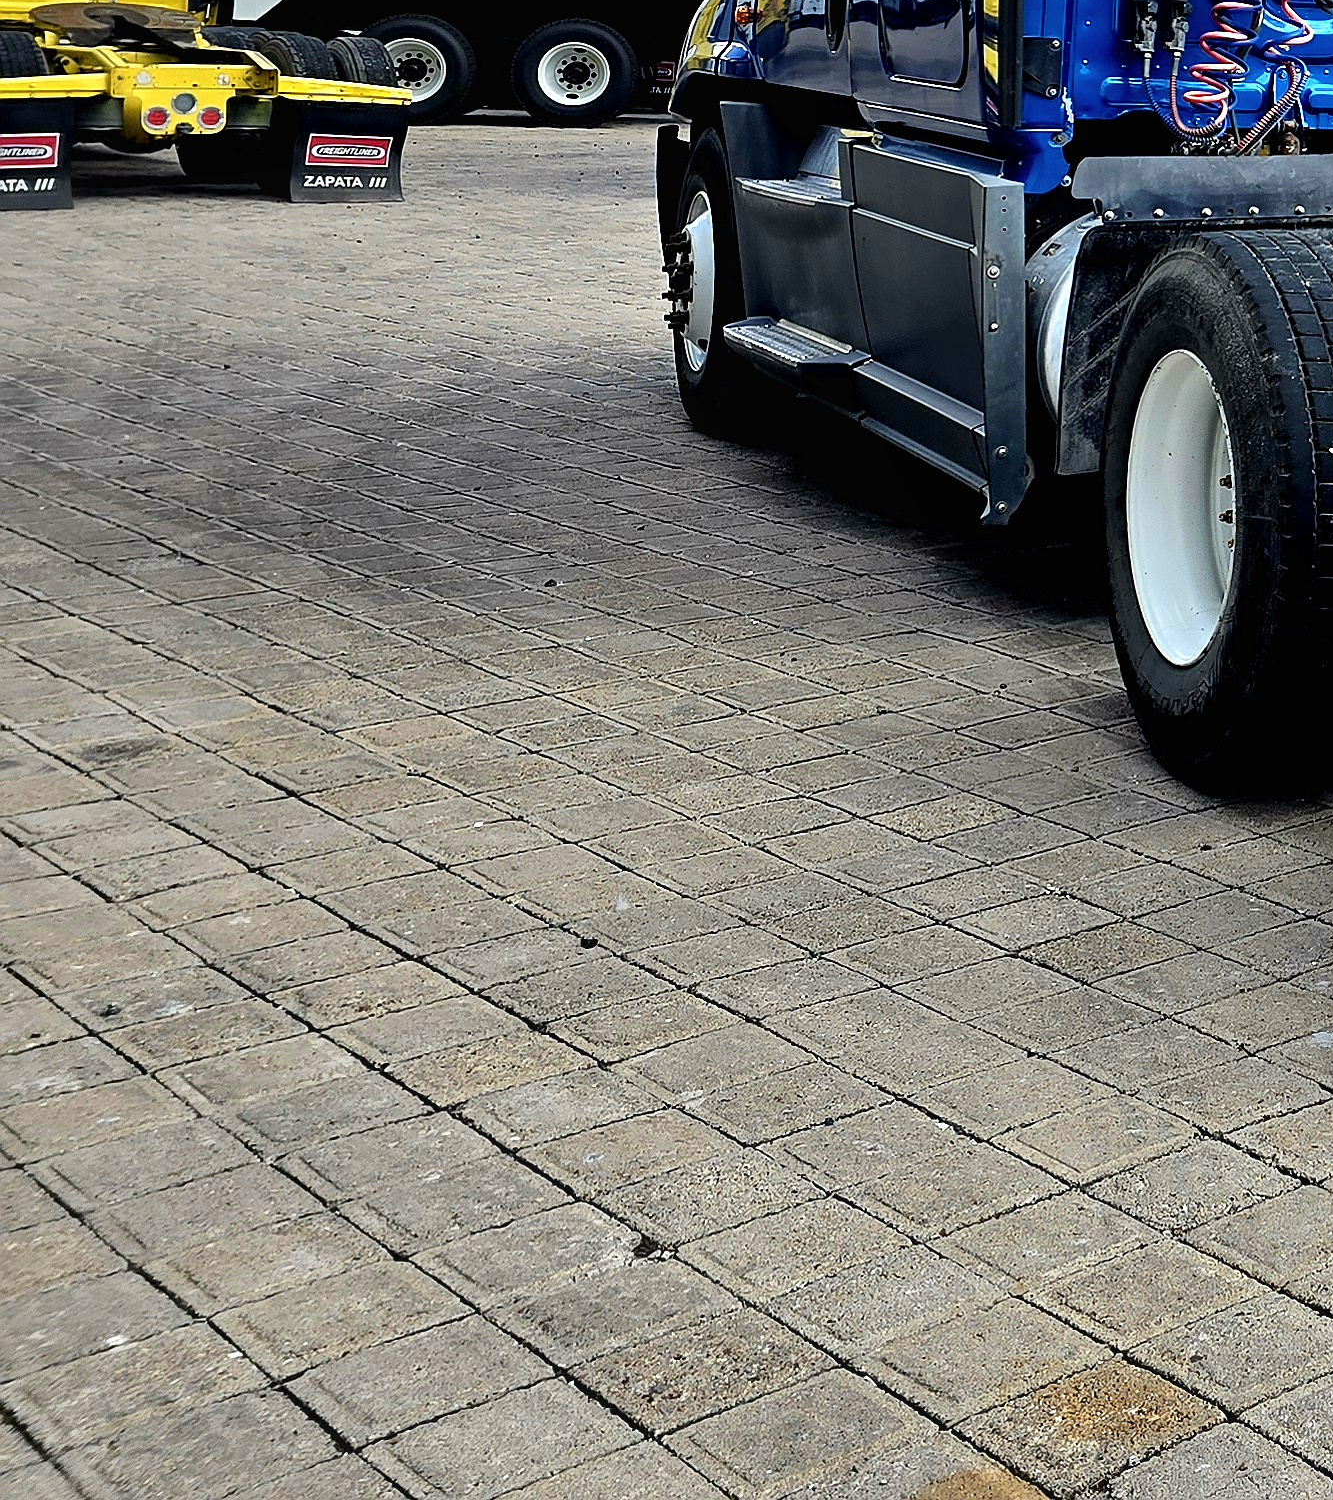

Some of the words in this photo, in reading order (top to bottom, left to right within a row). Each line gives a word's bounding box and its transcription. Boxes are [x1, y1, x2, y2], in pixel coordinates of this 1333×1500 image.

[318, 147, 379, 156] FREIGHTLINER
[0, 179, 29, 192] ATA
[303, 175, 364, 188] ZAPATA
